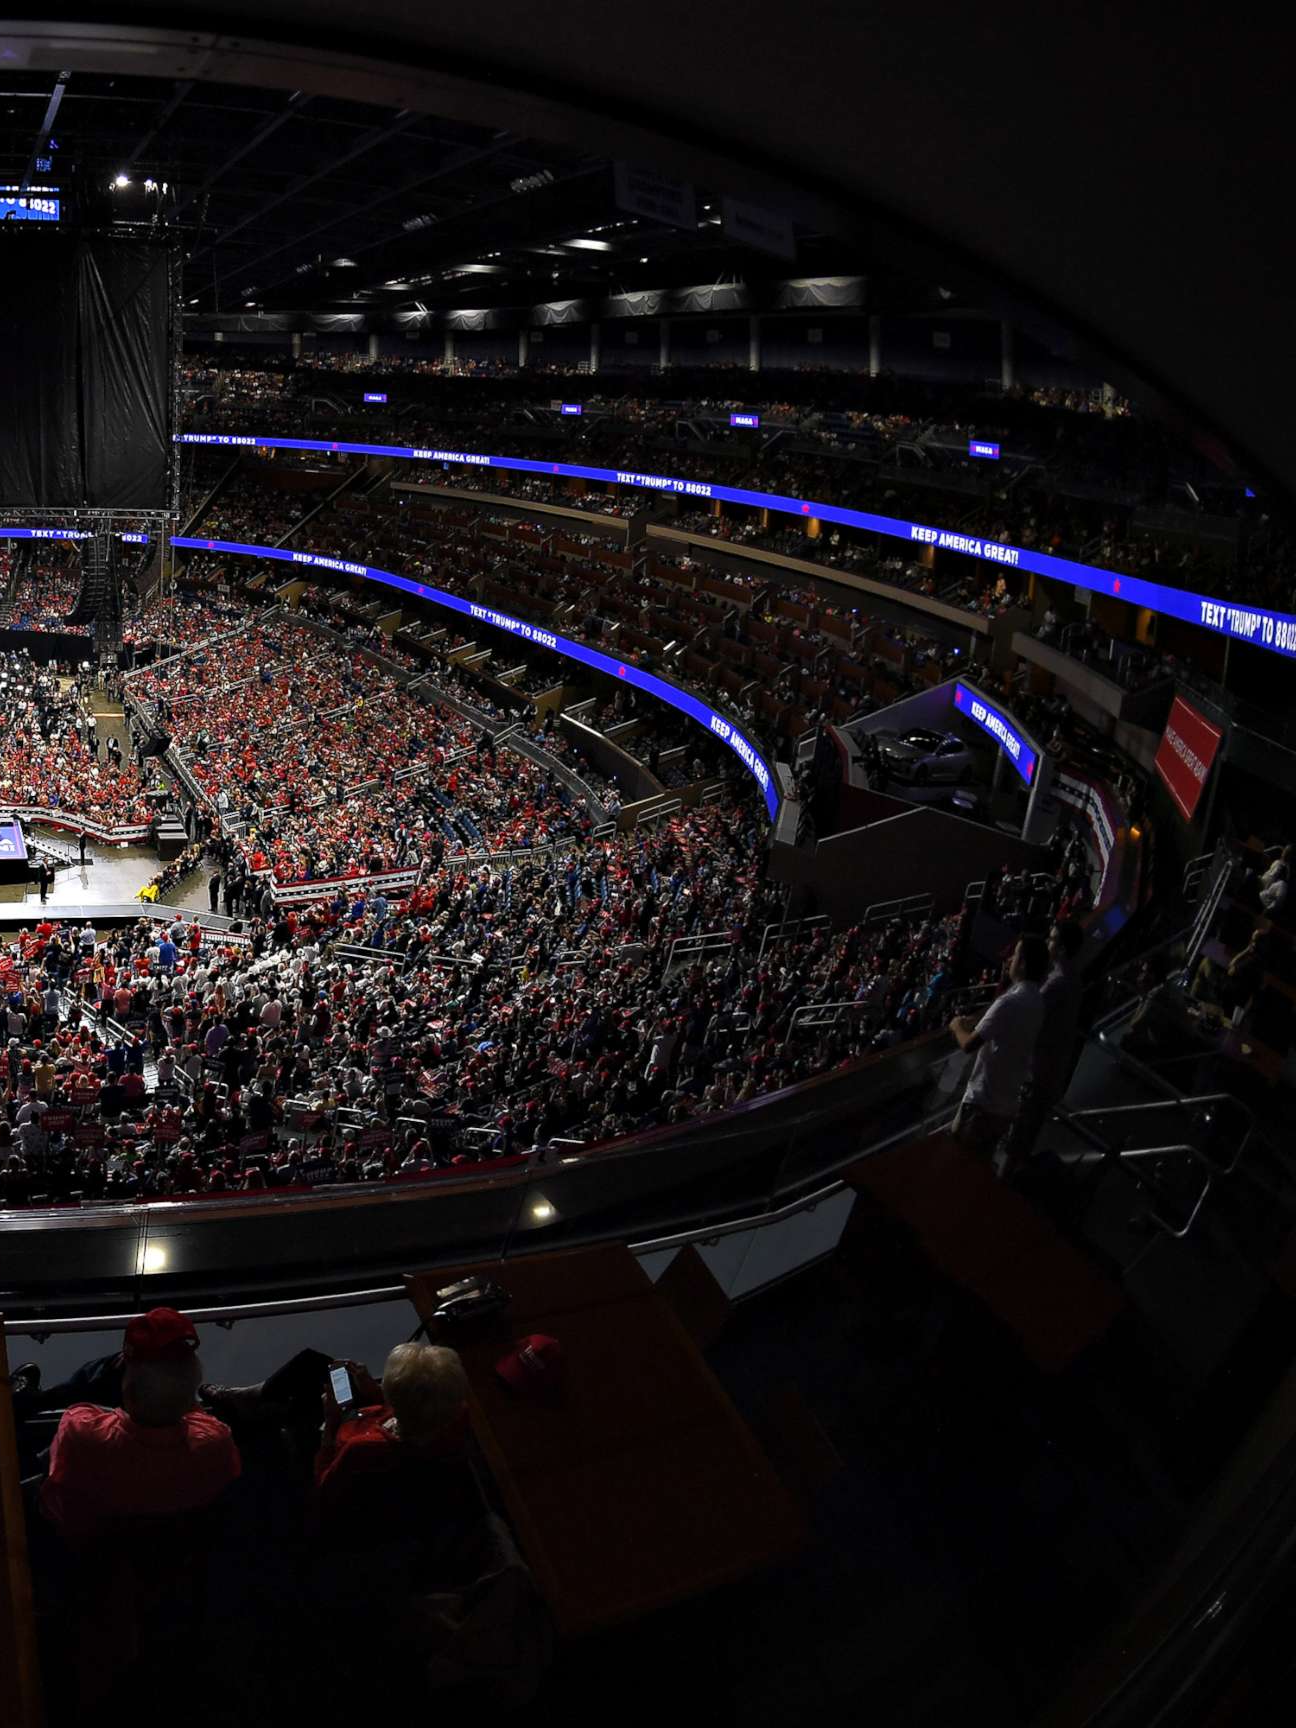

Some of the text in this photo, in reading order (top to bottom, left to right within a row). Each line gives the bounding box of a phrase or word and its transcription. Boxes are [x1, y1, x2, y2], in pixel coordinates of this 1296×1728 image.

[218, 436, 230, 444] TO
[413, 450, 432, 459] KEEP
[432, 452, 464, 462] AMERICA
[617, 473, 635, 483] TEXT
[673, 480, 684, 491] TO
[685, 483, 712, 496] 88022
[292, 553, 313, 563] KEEP
[313, 557, 344, 570] AMERICA
[911, 526, 1019, 565] KEEP AMERICA GREAT!
[470, 604, 487, 619] TEXT
[520, 624, 532, 636] TO
[532, 629, 557, 648] 88022
[1201, 601, 1226, 629] TEXT
[1261, 616, 1274, 644] TO
[971, 701, 987, 722] KEEP
[985, 712, 1008, 743] AMERICA
[710, 715, 730, 738] KEEP
[730, 731, 754, 769] AMERICA
